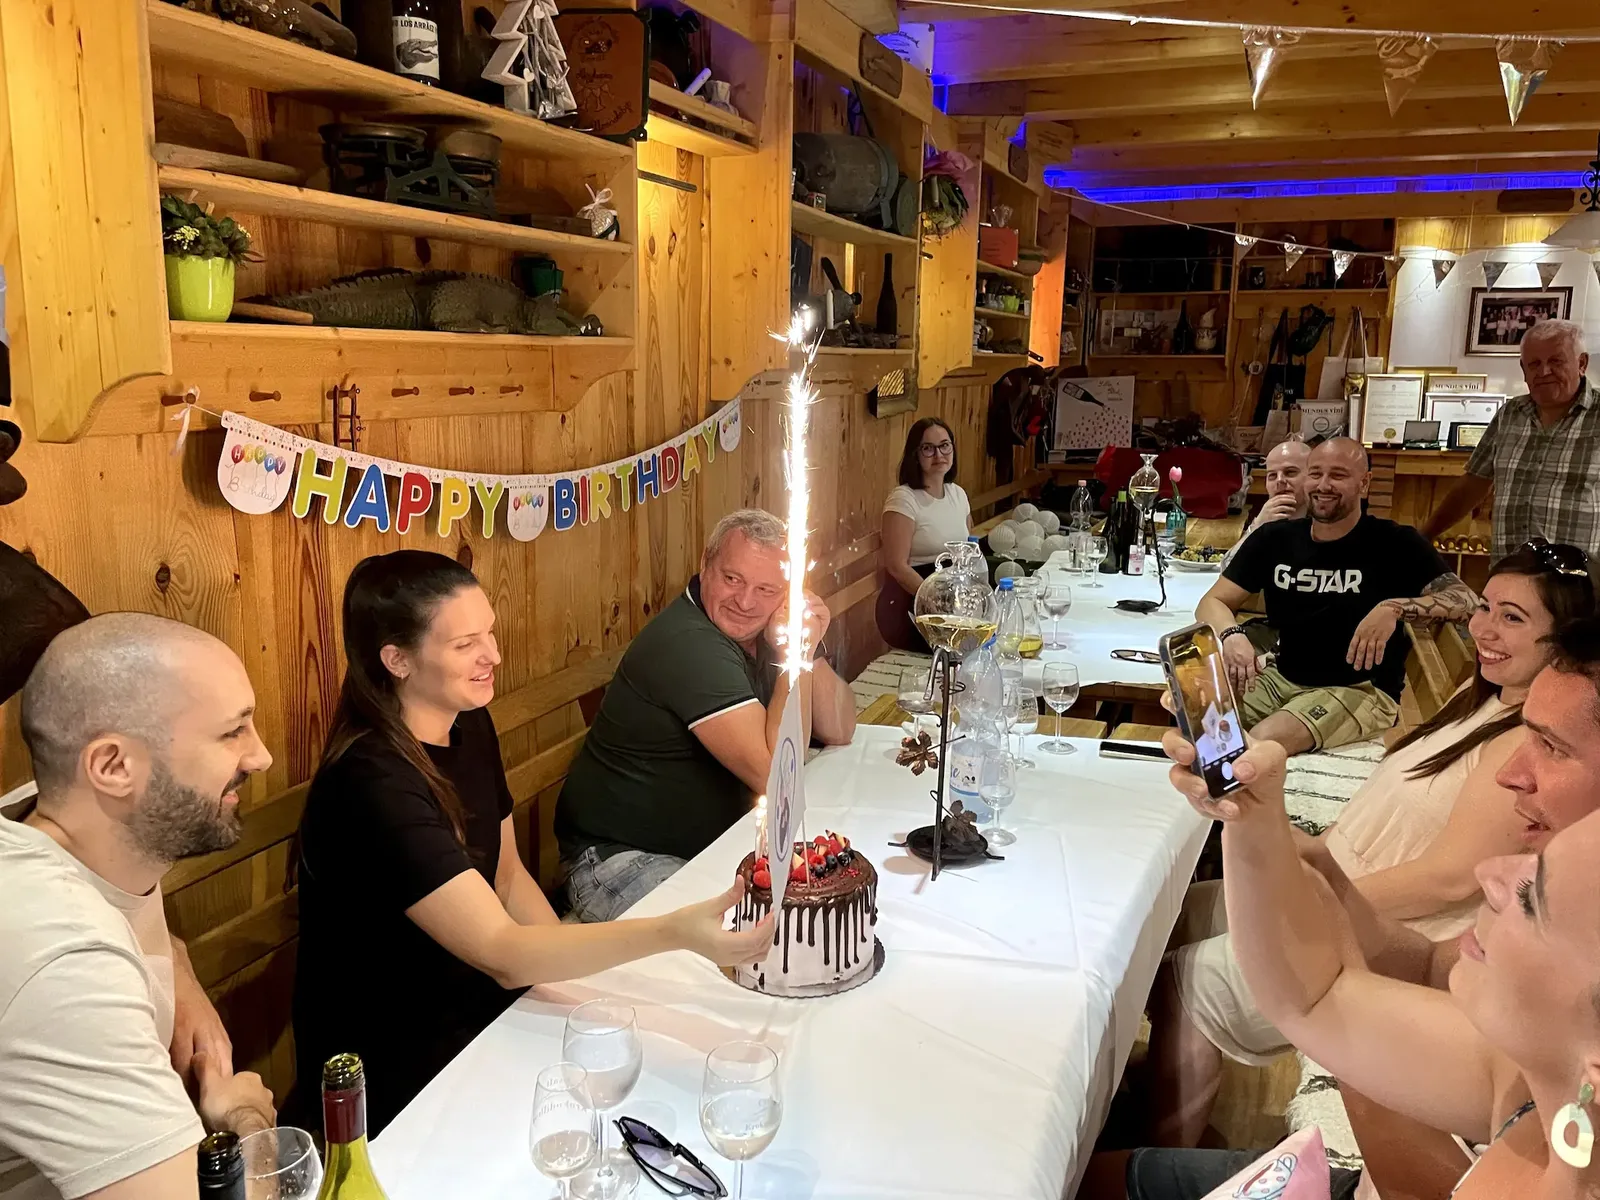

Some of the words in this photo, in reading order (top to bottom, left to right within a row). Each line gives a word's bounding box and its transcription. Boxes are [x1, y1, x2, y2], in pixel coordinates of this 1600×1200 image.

[400, 20, 412, 28] LOS
[292, 446, 504, 539] HAPPY
[553, 418, 718, 531] BIRTHDAY
[1274, 563, 1363, 594] G-STAR
